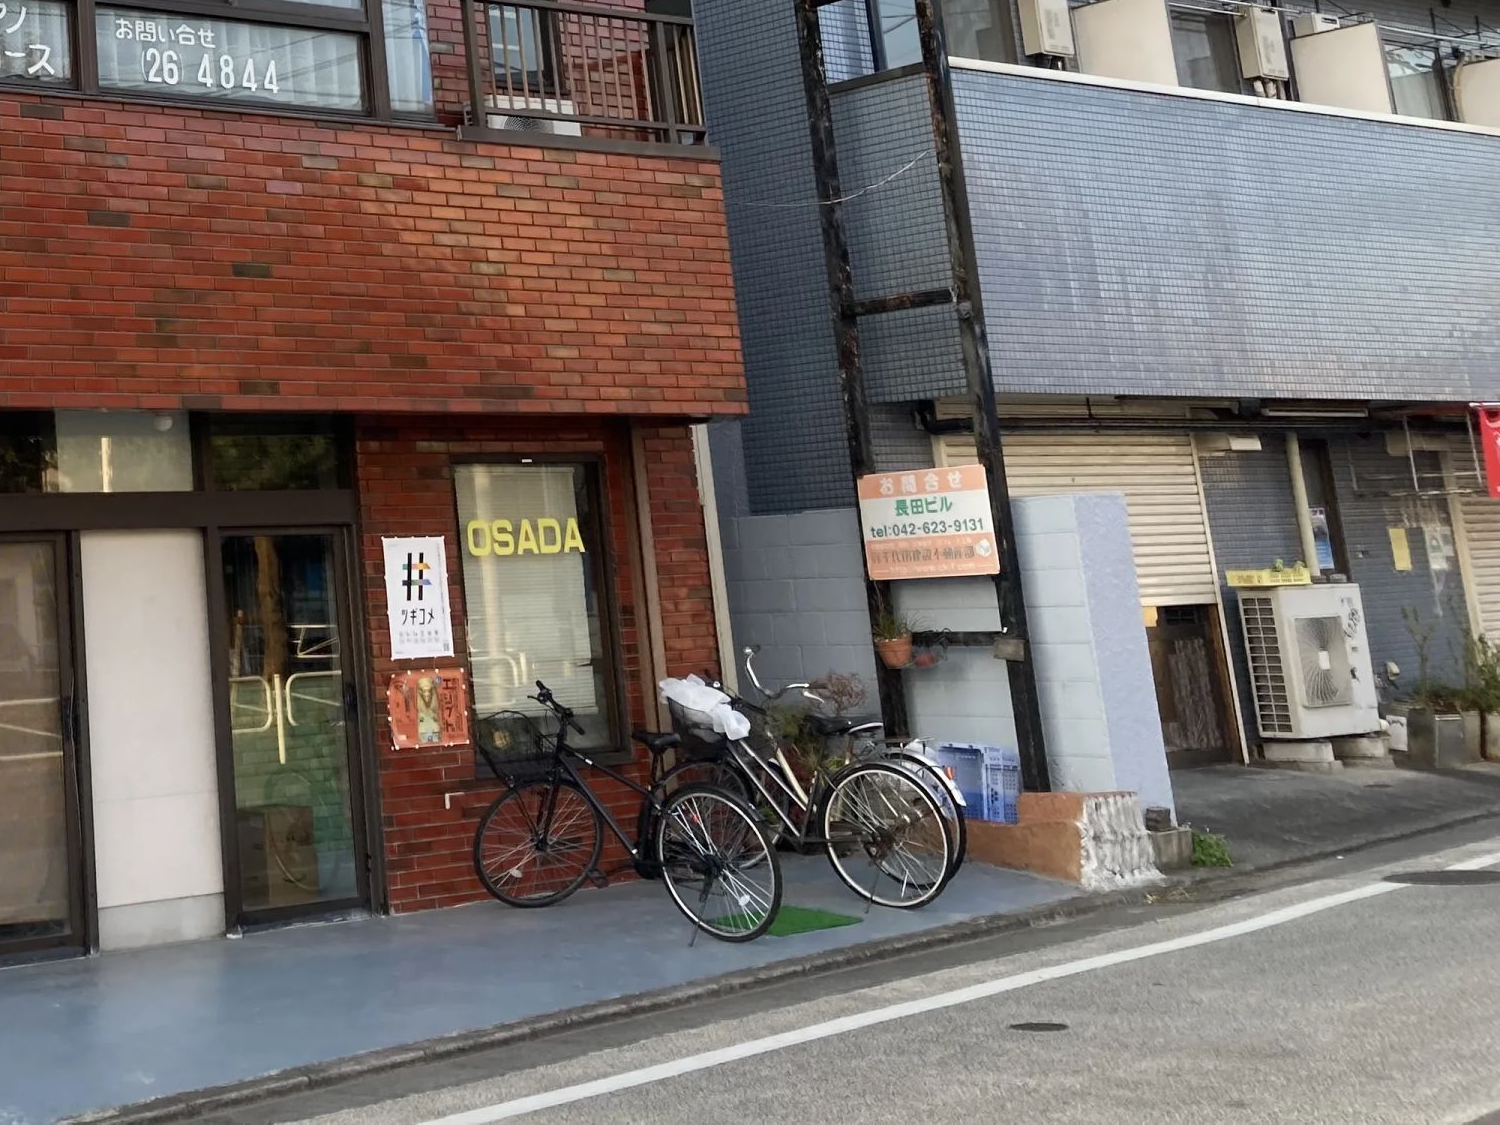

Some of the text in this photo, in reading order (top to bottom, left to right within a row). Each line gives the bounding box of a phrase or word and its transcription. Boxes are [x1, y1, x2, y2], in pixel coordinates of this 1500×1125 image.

[115, 18, 216, 48] お問い合せ
[141, 48, 279, 94] (26) 4844
[880, 470, 962, 495] お問合せ
[895, 496, 953, 516] 長田ビル
[467, 517, 586, 556] OSADA
[870, 517, 984, 538] tel:042-623-9131
